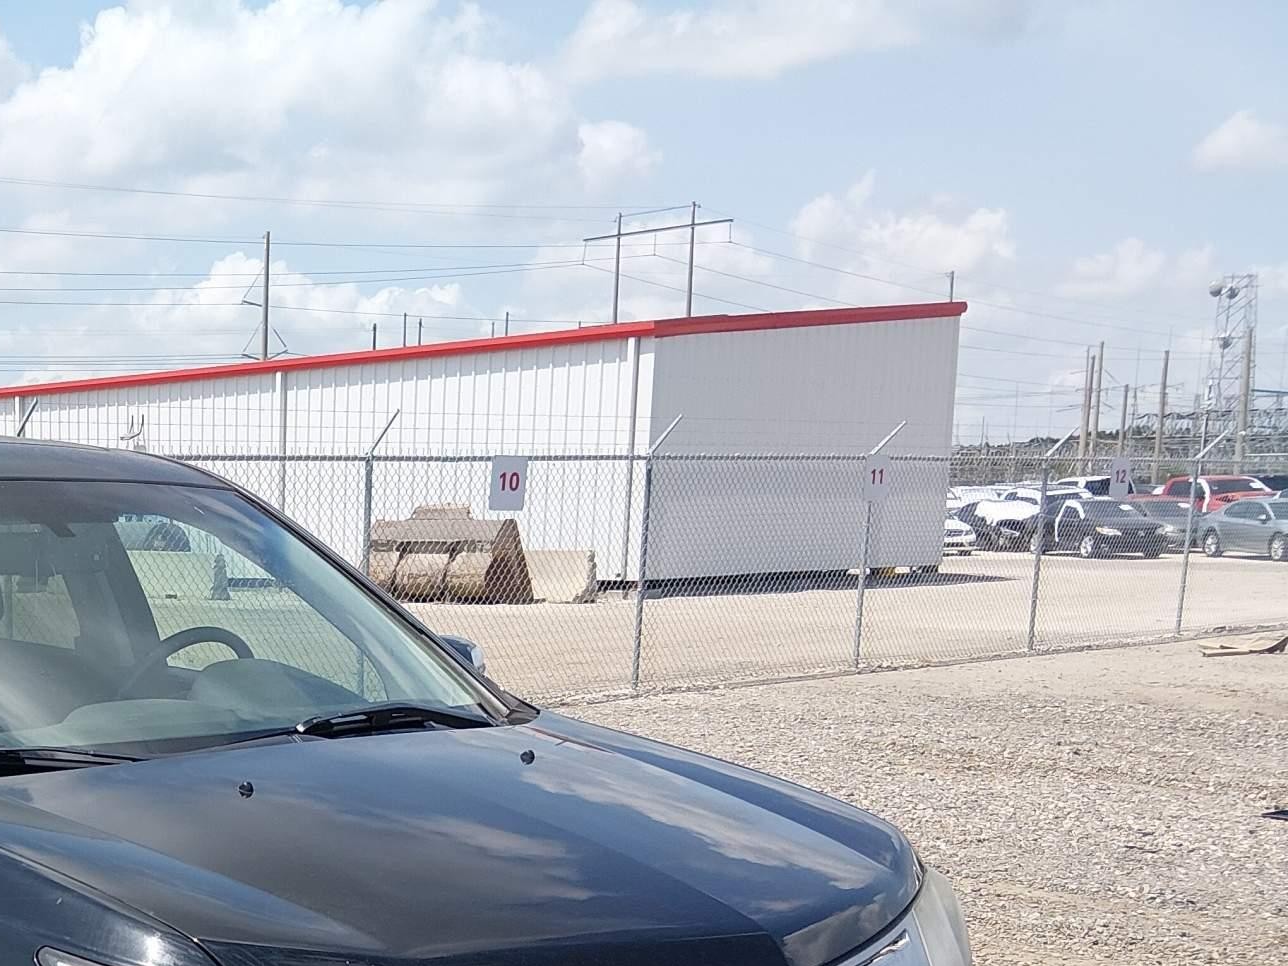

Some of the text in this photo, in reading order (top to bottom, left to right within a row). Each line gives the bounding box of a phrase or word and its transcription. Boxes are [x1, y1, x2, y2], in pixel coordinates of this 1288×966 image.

[499, 471, 520, 492] 10
[871, 468, 884, 484] 11
[1115, 469, 1127, 483] 12
